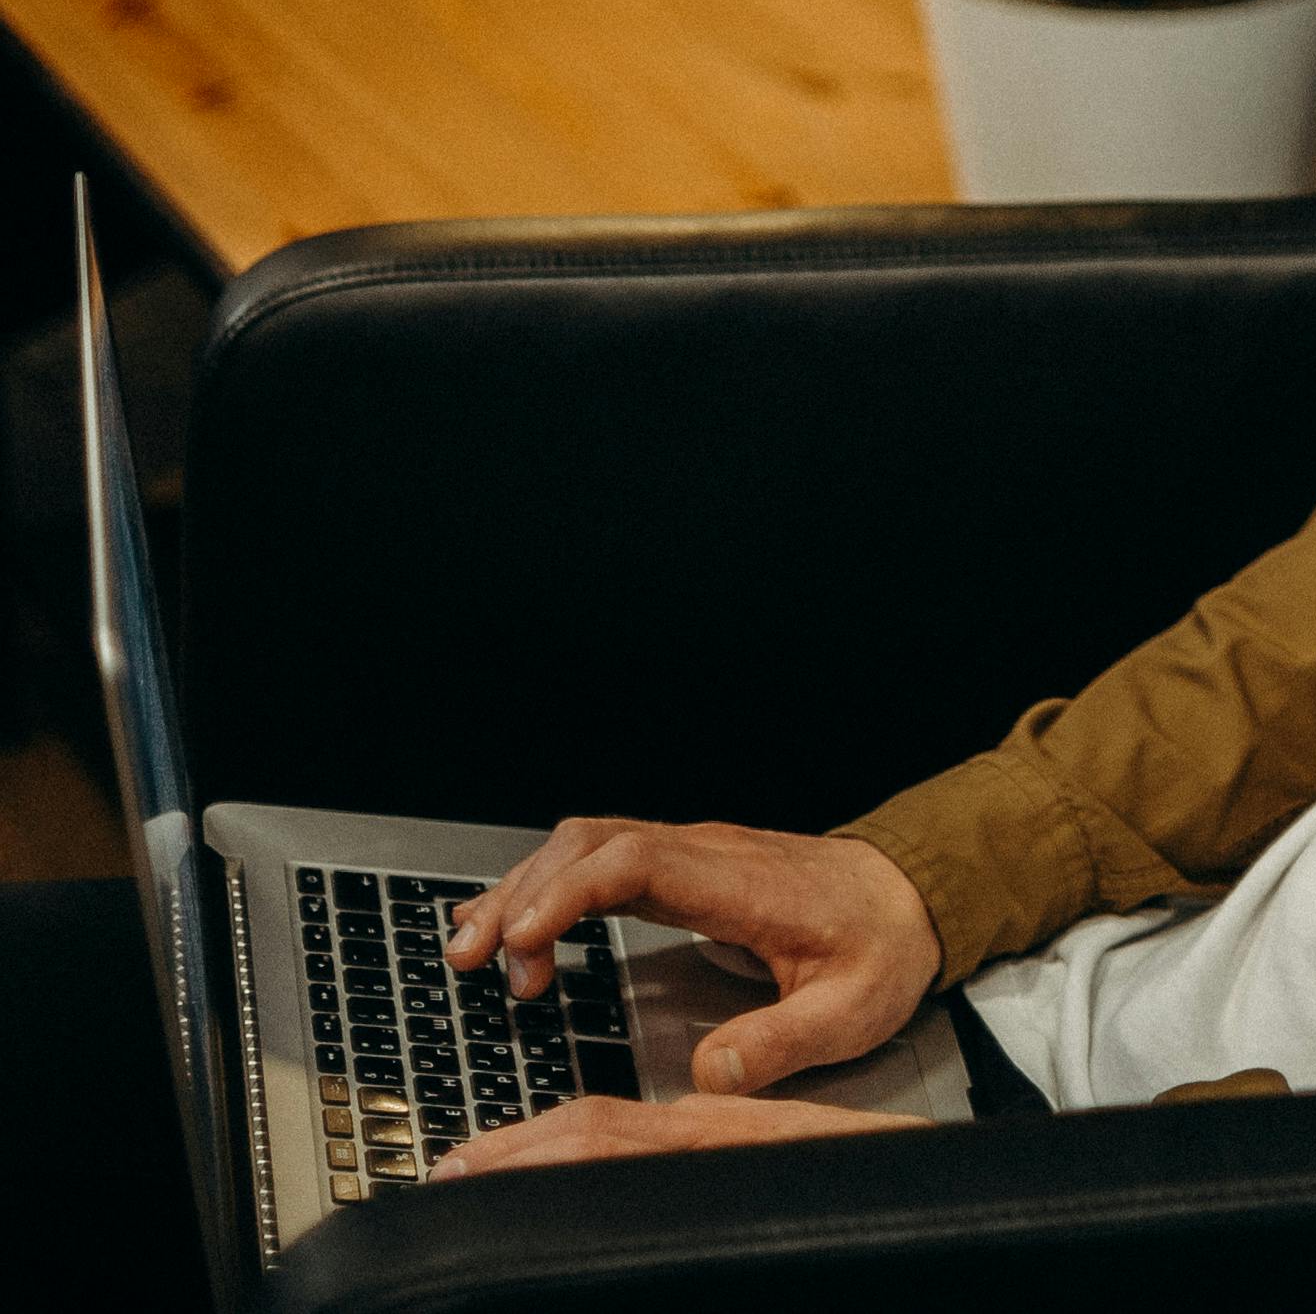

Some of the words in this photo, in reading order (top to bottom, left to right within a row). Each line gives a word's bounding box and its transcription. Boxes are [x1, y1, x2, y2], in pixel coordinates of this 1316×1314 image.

[433, 1019, 448, 1030] Ш
[471, 1028, 486, 1036] K
[420, 1060, 434, 1069] U
[477, 1058, 492, 1066] J
[535, 1077, 551, 1086] N
[424, 1090, 439, 1098] Y
[480, 1087, 496, 1096] H
[502, 1106, 518, 1115] П
[485, 1118, 501, 1128] G
